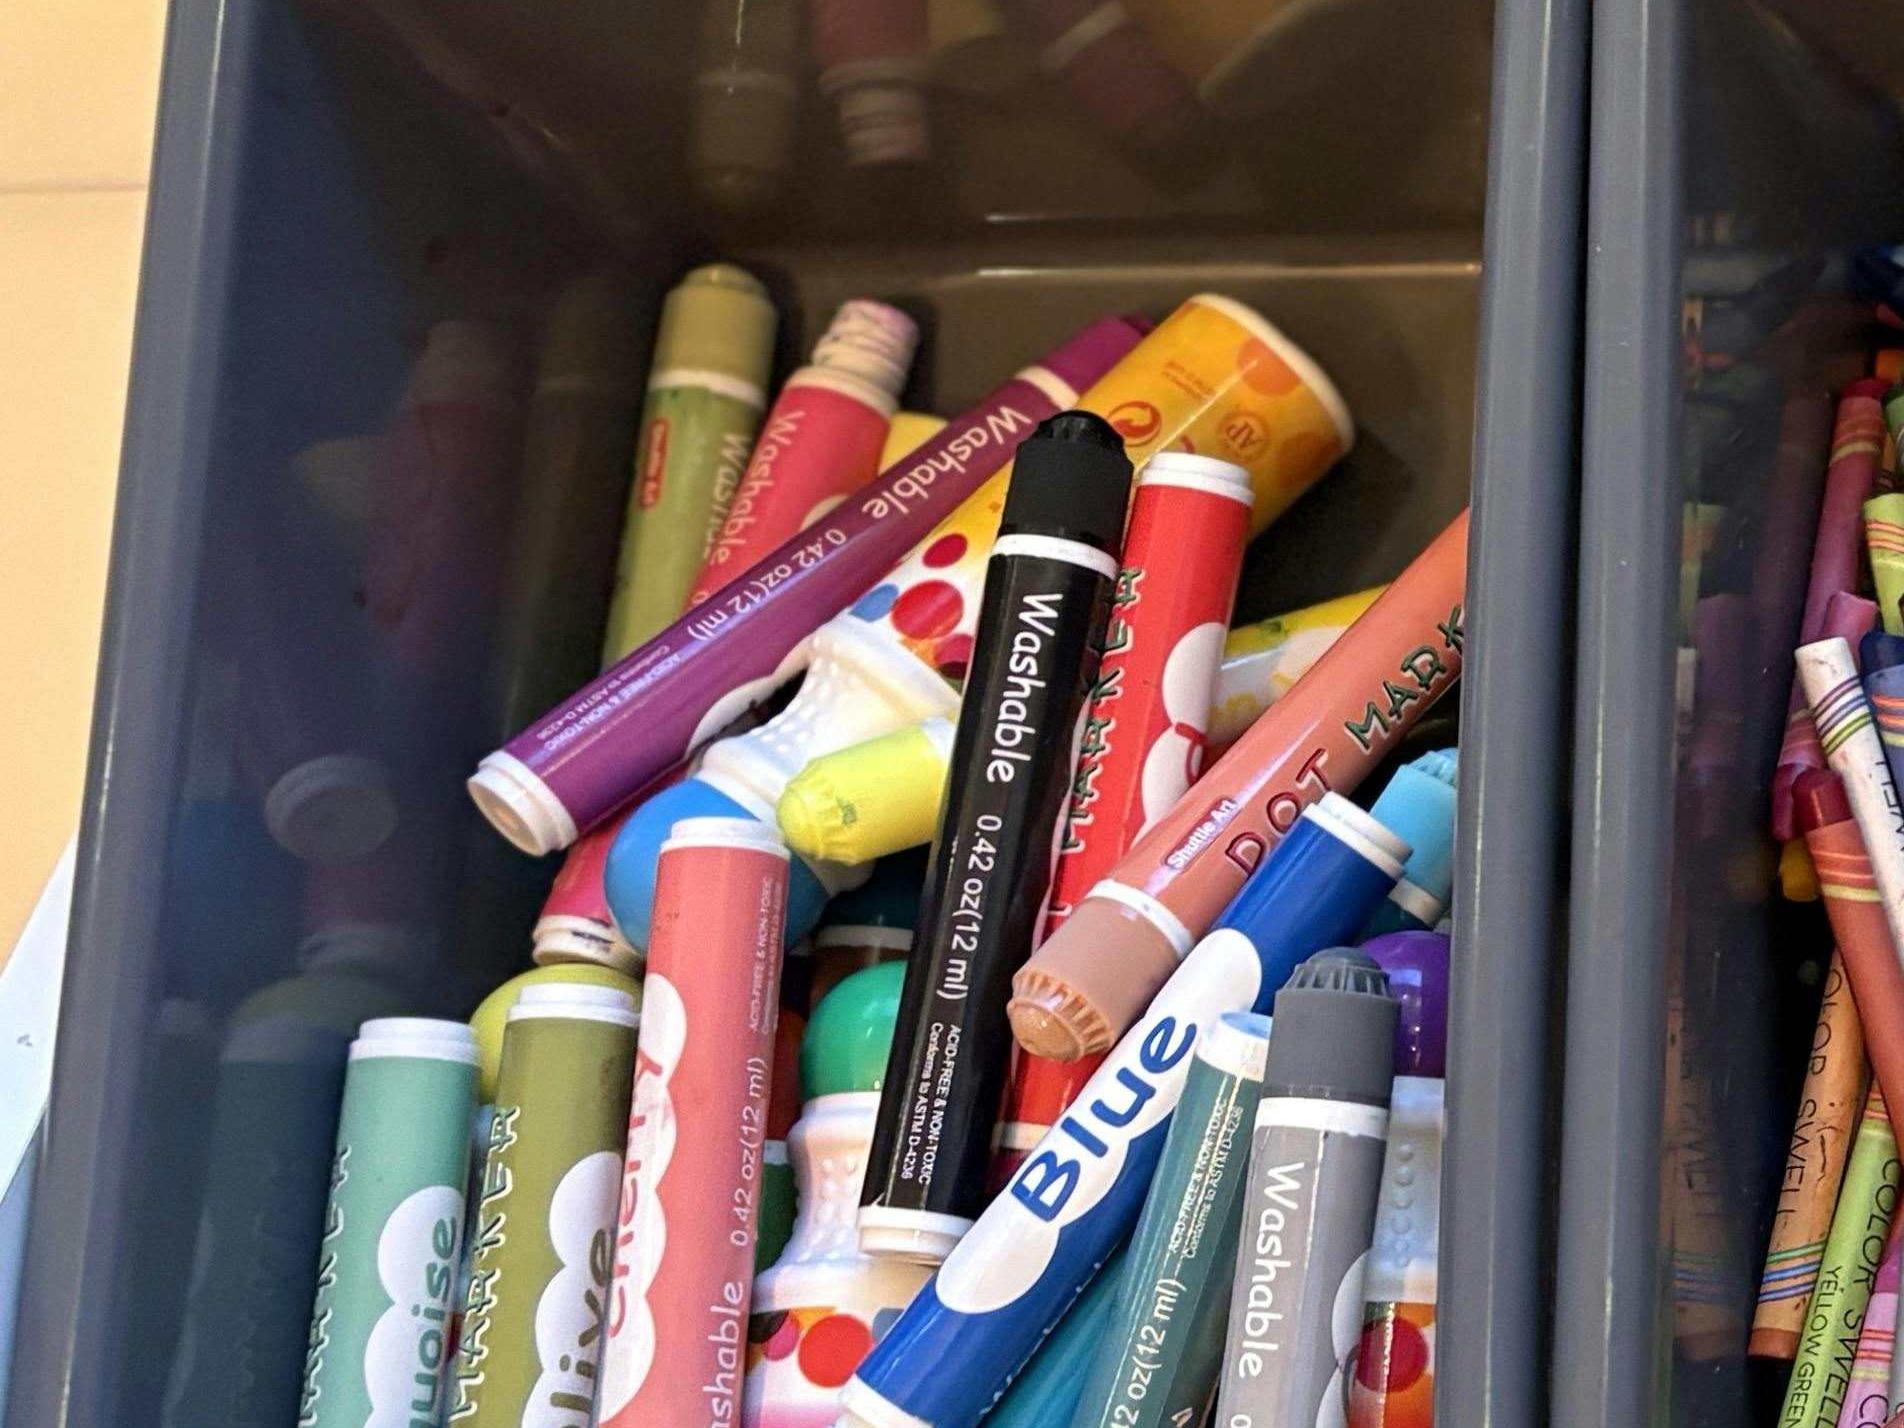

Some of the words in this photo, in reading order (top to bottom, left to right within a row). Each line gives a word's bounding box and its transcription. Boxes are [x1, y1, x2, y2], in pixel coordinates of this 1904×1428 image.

[712, 410, 806, 566] Washable
[863, 397, 1031, 520] Washable
[792, 528, 848, 570] 0.42
[688, 609, 729, 642] ml)
[727, 565, 792, 621] oz(12
[987, 592, 1064, 783] Washable
[1225, 746, 1332, 879] DOT
[1344, 602, 1466, 755] MARK
[967, 815, 1002, 876] 0.42
[1165, 821, 1215, 871] Shuttle
[1209, 795, 1237, 830] Art
[950, 878, 985, 952] oz(12
[935, 953, 969, 1000] ml)
[748, 1056, 768, 1100] ml)
[936, 1024, 962, 1097] ACID-FREE
[738, 1093, 765, 1182] oz(12
[918, 1110, 945, 1185] NON-TOXIC
[1008, 1015, 1198, 1223] Blue
[729, 1183, 755, 1248] 0.42
[1854, 1157, 1902, 1297] COLOR
[1237, 1161, 1305, 1379] Washable
[1128, 1322, 1168, 1402] oz(12
[1153, 1276, 1188, 1322] ml)
[1801, 1264, 1842, 1356] YELLOW
